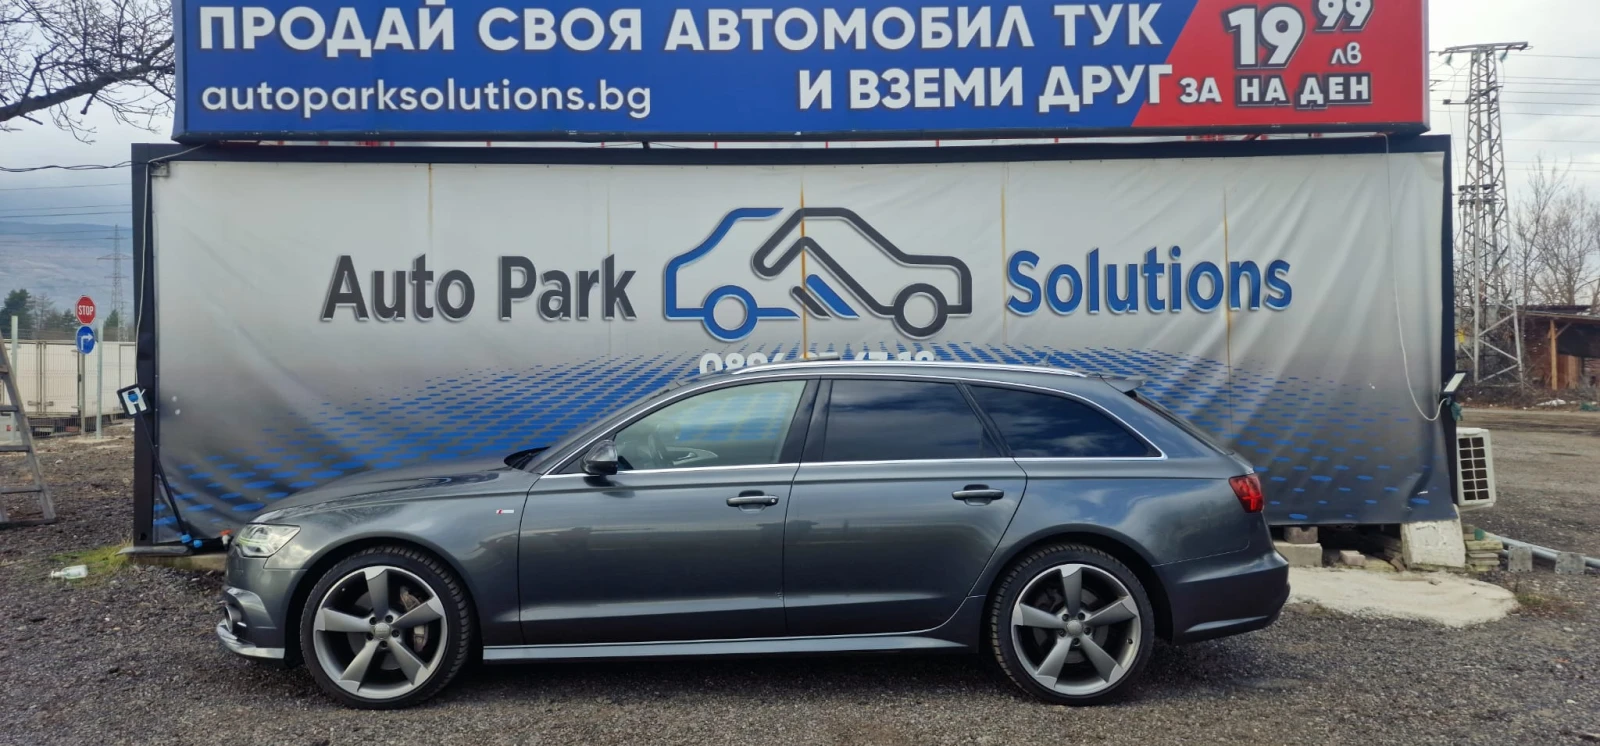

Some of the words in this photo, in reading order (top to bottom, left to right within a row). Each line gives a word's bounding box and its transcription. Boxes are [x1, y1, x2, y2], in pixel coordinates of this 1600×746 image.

[200, 0, 455, 58] ПРОДАЙ
[478, 7, 643, 51] СВОЯ
[664, 5, 1035, 51] АВТОМОБИЛ
[1053, 3, 1163, 46] ТУК
[1227, 6, 1304, 66] 19
[1317, 0, 1373, 27] 99
[202, 77, 652, 119] autoparksolutions.bg
[799, 69, 832, 110] И
[849, 66, 1023, 109] ВЗЕМИ
[1038, 64, 1173, 113] ДРУГ
[1179, 77, 1222, 104] ЗА
[1240, 76, 1287, 102] НА
[1300, 75, 1370, 105] ДЕН
[321, 253, 476, 322] Auto
[497, 253, 638, 322] Park
[1007, 244, 1294, 316] Solutions
[78, 305, 94, 315] STOP
